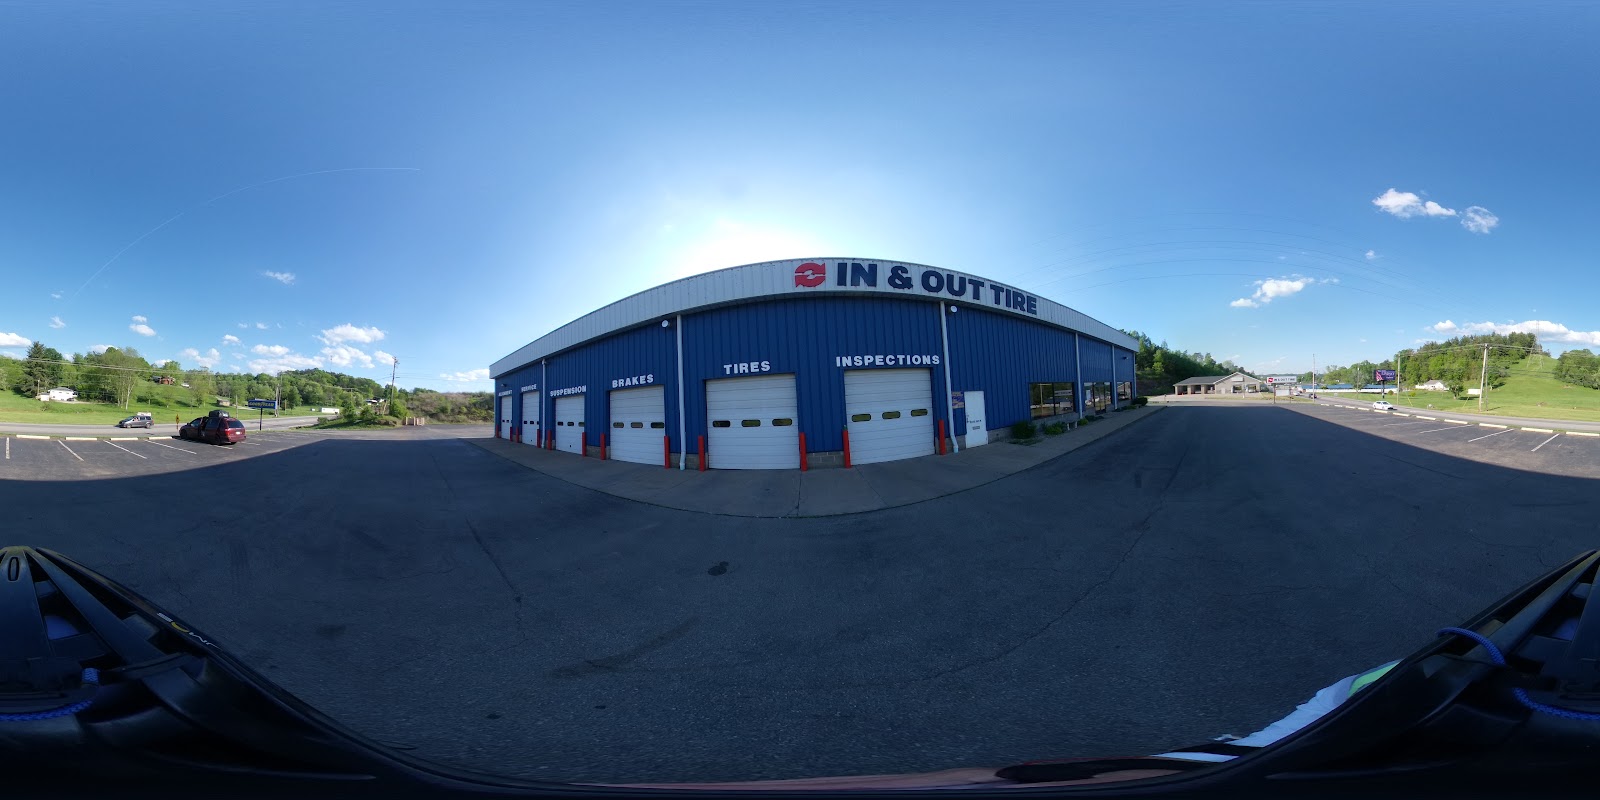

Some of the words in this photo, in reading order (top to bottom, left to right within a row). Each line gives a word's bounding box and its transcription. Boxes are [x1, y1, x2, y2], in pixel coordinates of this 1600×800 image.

[837, 262, 878, 287] IN
[887, 265, 914, 290] &
[921, 270, 985, 301] OUT
[990, 283, 1038, 315] TIRE
[723, 360, 771, 375] TIRES
[836, 354, 940, 367] INSPECTIONS
[612, 373, 654, 388] BRAKES
[550, 385, 587, 397] SUSPENSION
